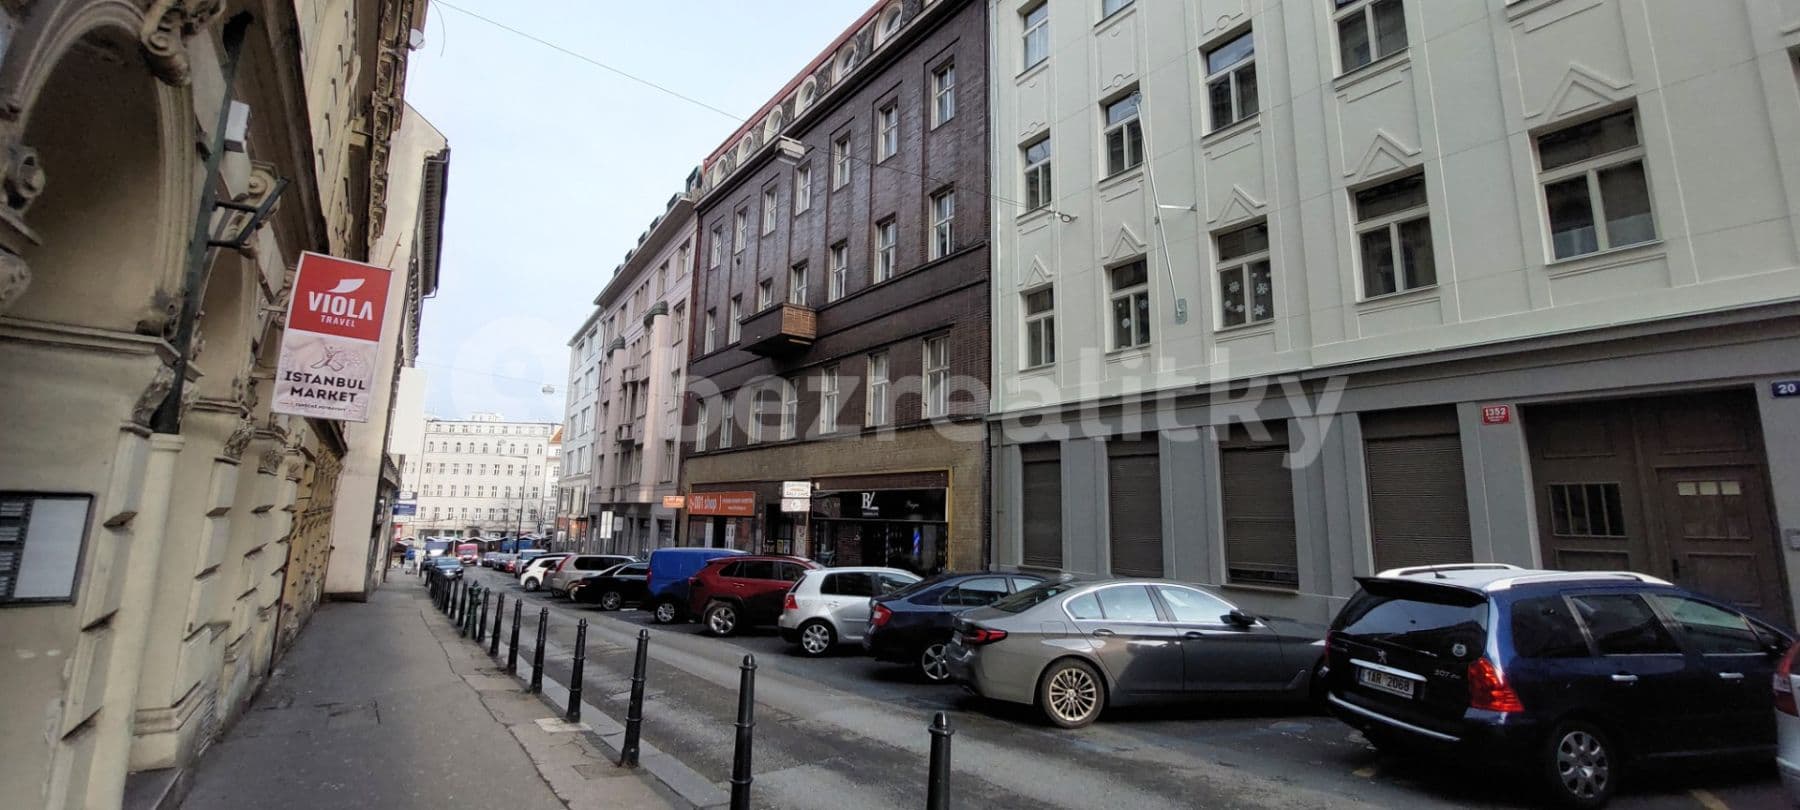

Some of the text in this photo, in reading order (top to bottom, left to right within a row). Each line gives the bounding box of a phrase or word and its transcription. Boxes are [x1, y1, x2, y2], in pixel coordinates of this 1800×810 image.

[308, 291, 373, 321] VIOLA
[320, 315, 356, 328] TRAVEL
[284, 370, 366, 391] ISTANBUL
[1777, 383, 1797, 395] 20
[289, 386, 358, 403] MARKET
[1485, 407, 1506, 417] 1352
[1366, 670, 1409, 691] 1AR 2068
